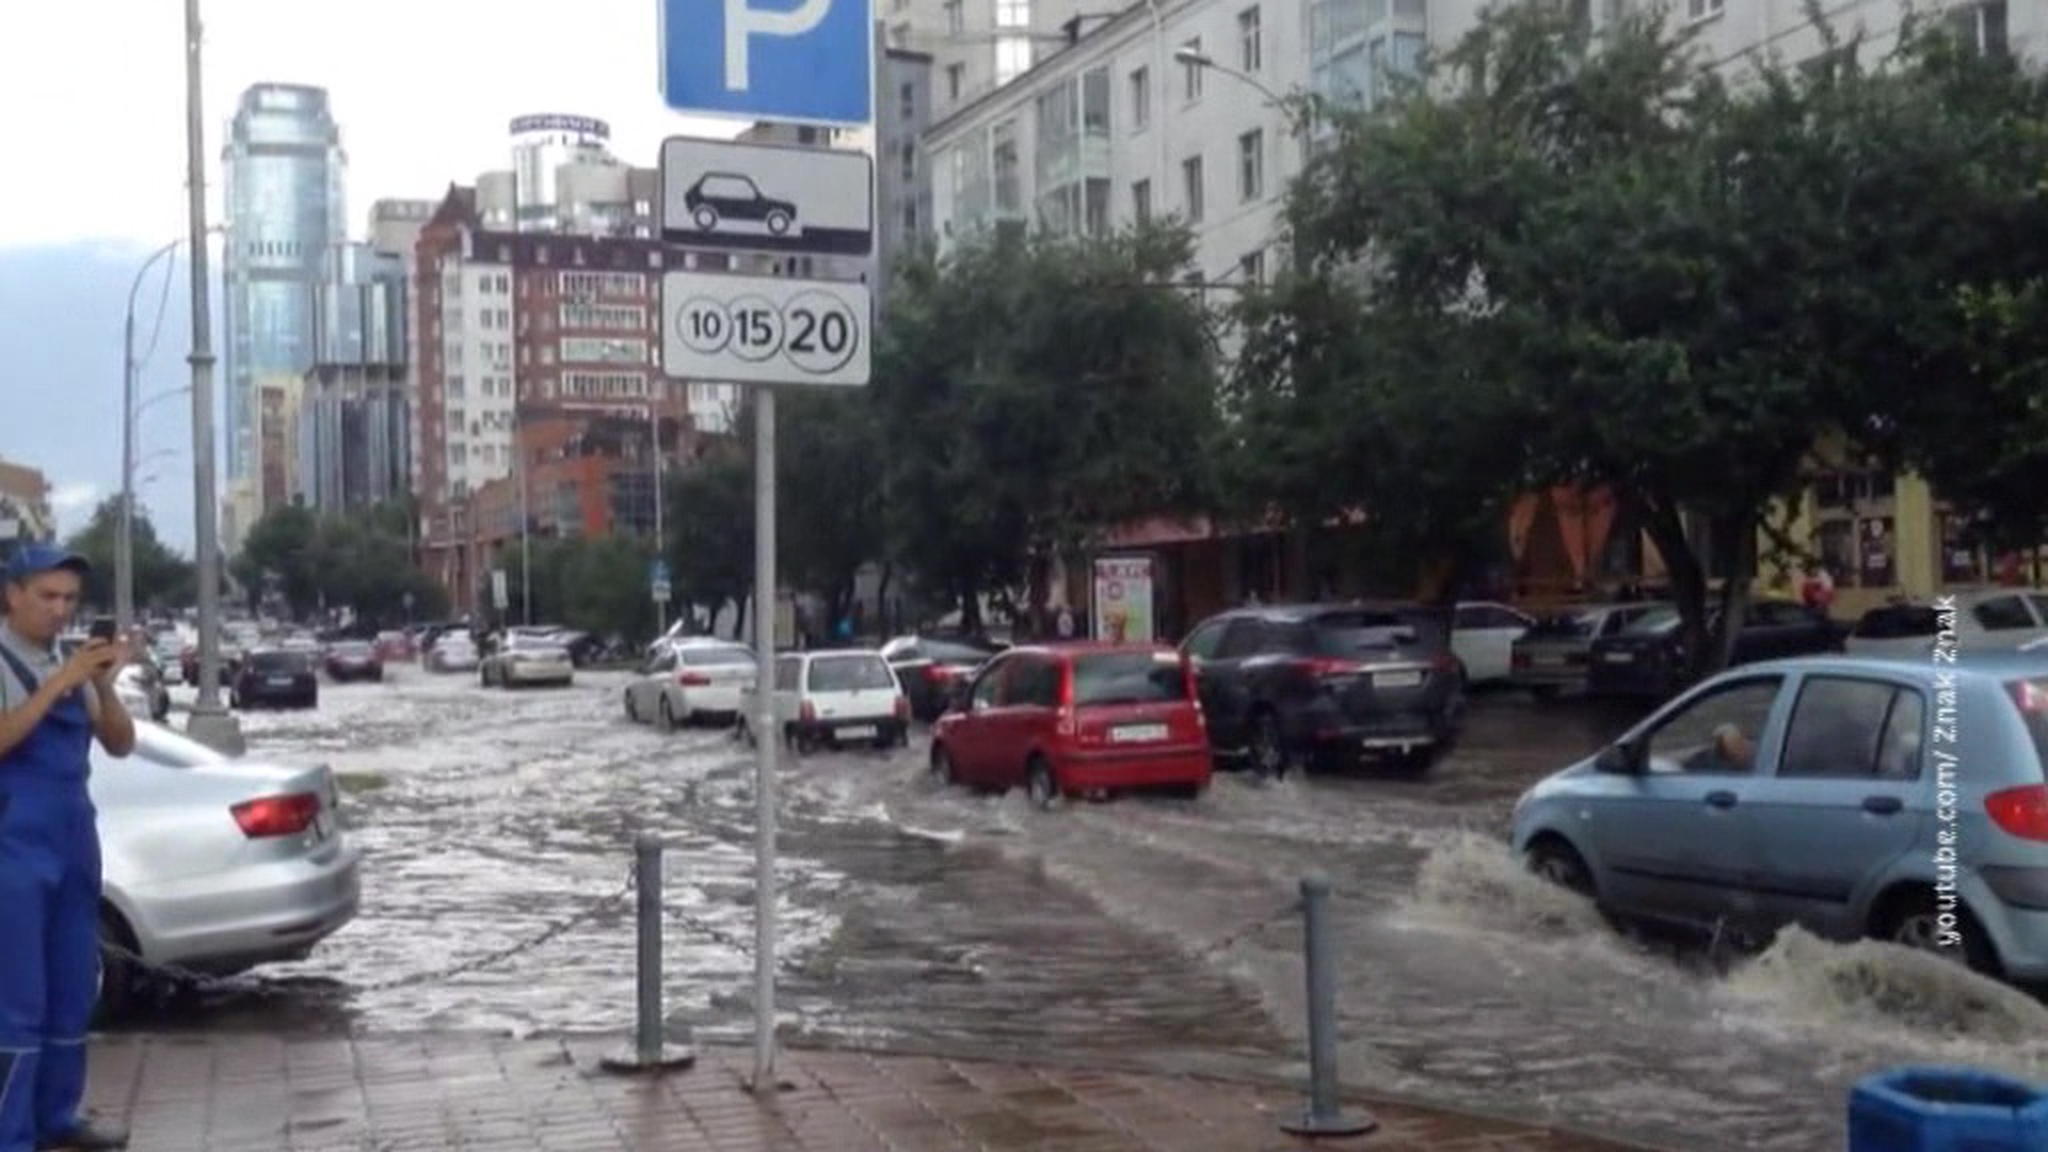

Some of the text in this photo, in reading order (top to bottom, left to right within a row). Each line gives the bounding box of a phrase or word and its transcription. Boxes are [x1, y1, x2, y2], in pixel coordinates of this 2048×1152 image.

[691, 309, 847, 353] 10 15 20
